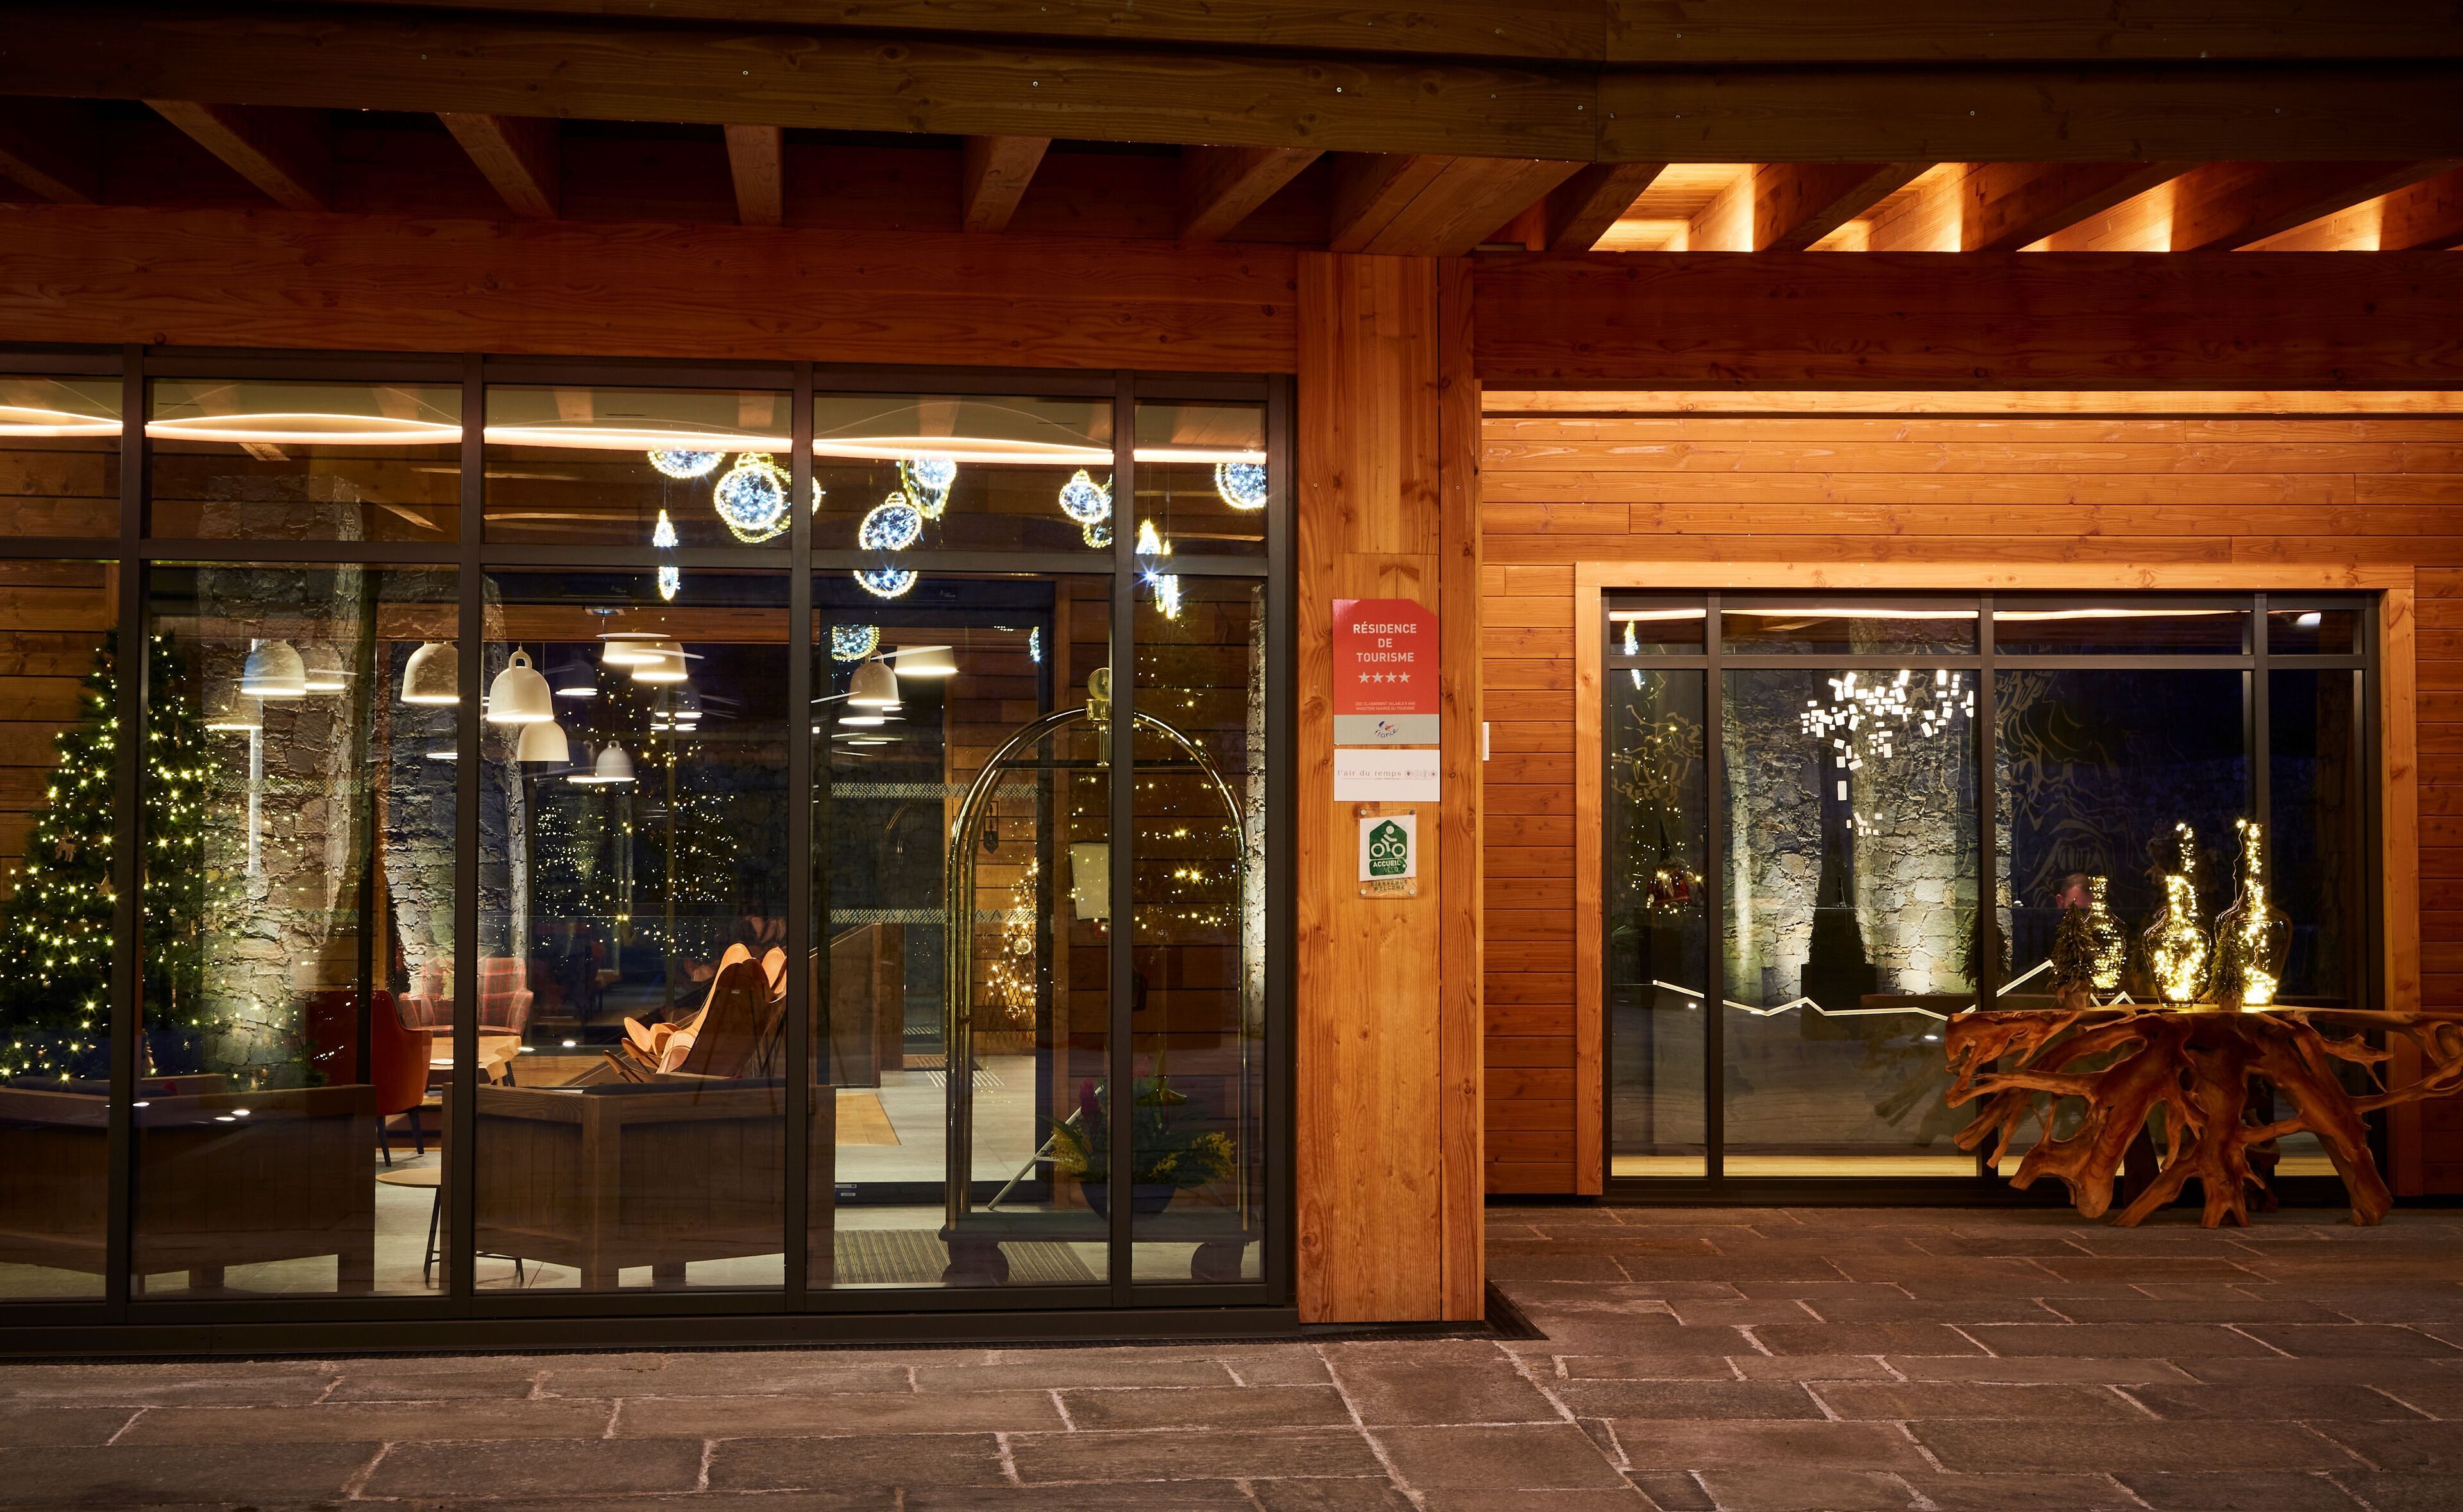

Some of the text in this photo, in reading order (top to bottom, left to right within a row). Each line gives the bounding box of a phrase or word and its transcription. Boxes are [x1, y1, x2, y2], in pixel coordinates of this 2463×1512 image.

[1353, 621, 1417, 634] RÉSIDENCE
[1378, 639, 1392, 648] DE
[1357, 653, 1414, 662] TOURISME
